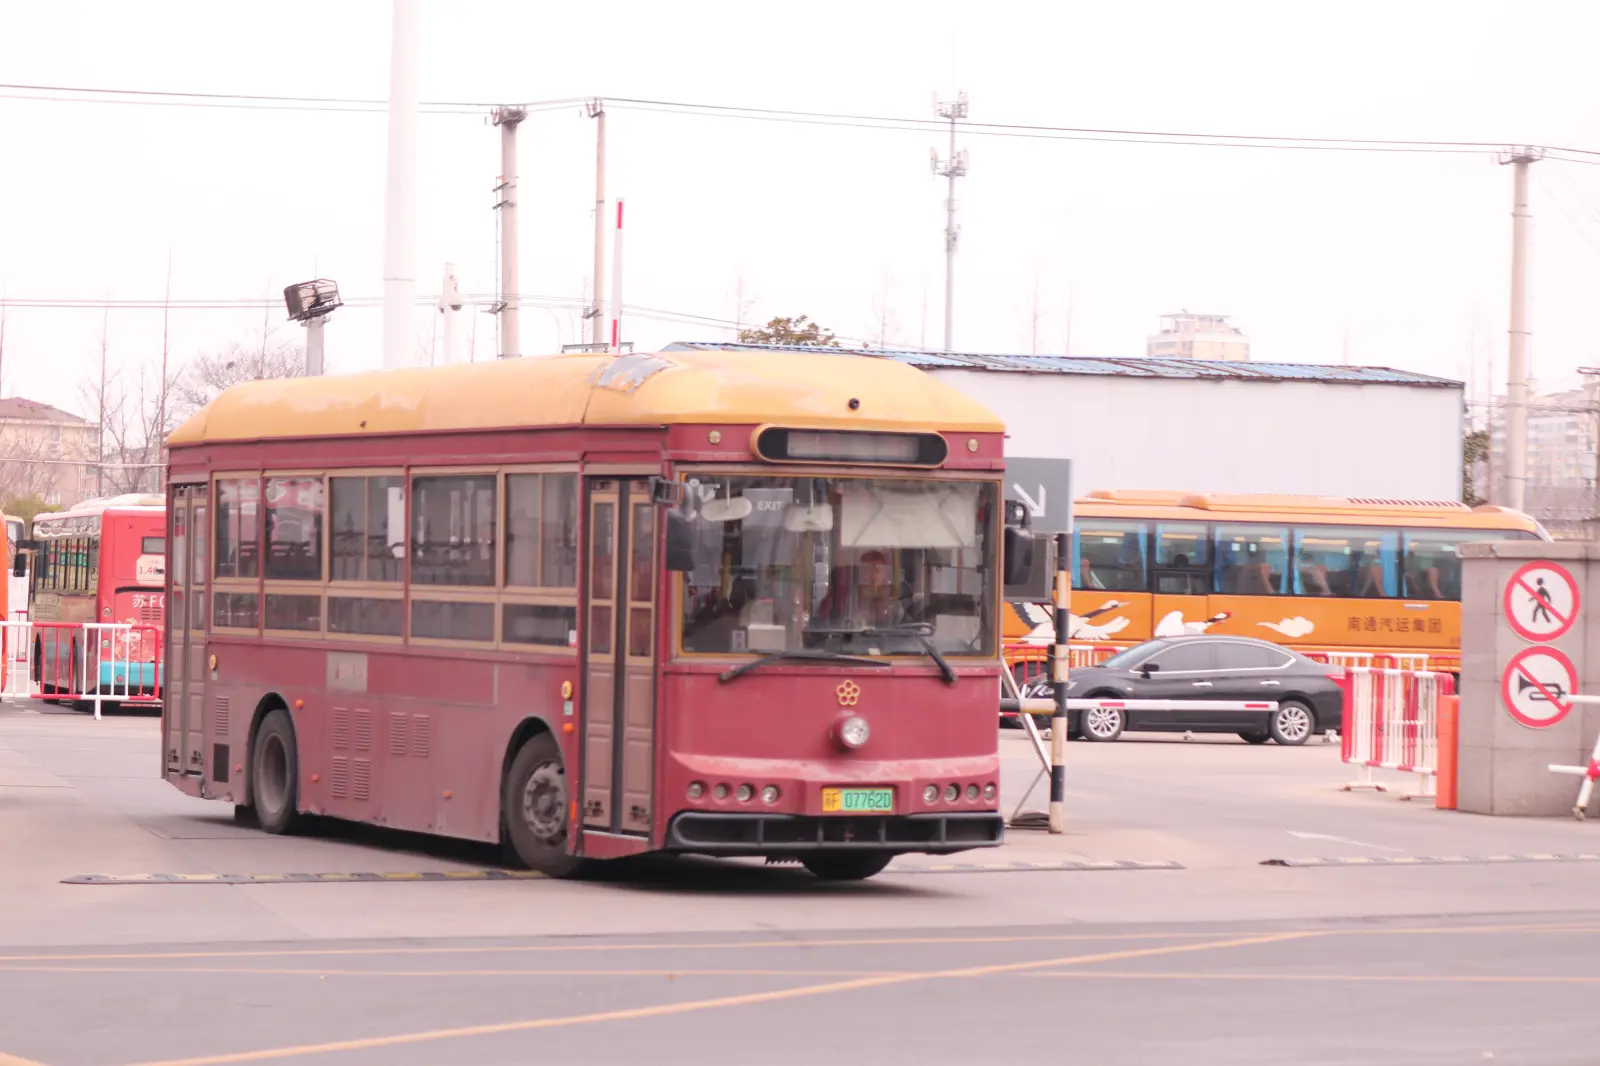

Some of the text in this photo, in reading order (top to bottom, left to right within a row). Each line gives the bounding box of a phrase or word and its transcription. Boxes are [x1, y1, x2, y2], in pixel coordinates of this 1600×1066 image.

[757, 500, 785, 511] EXIT
[1347, 616, 1442, 633] 南通汽运集团
